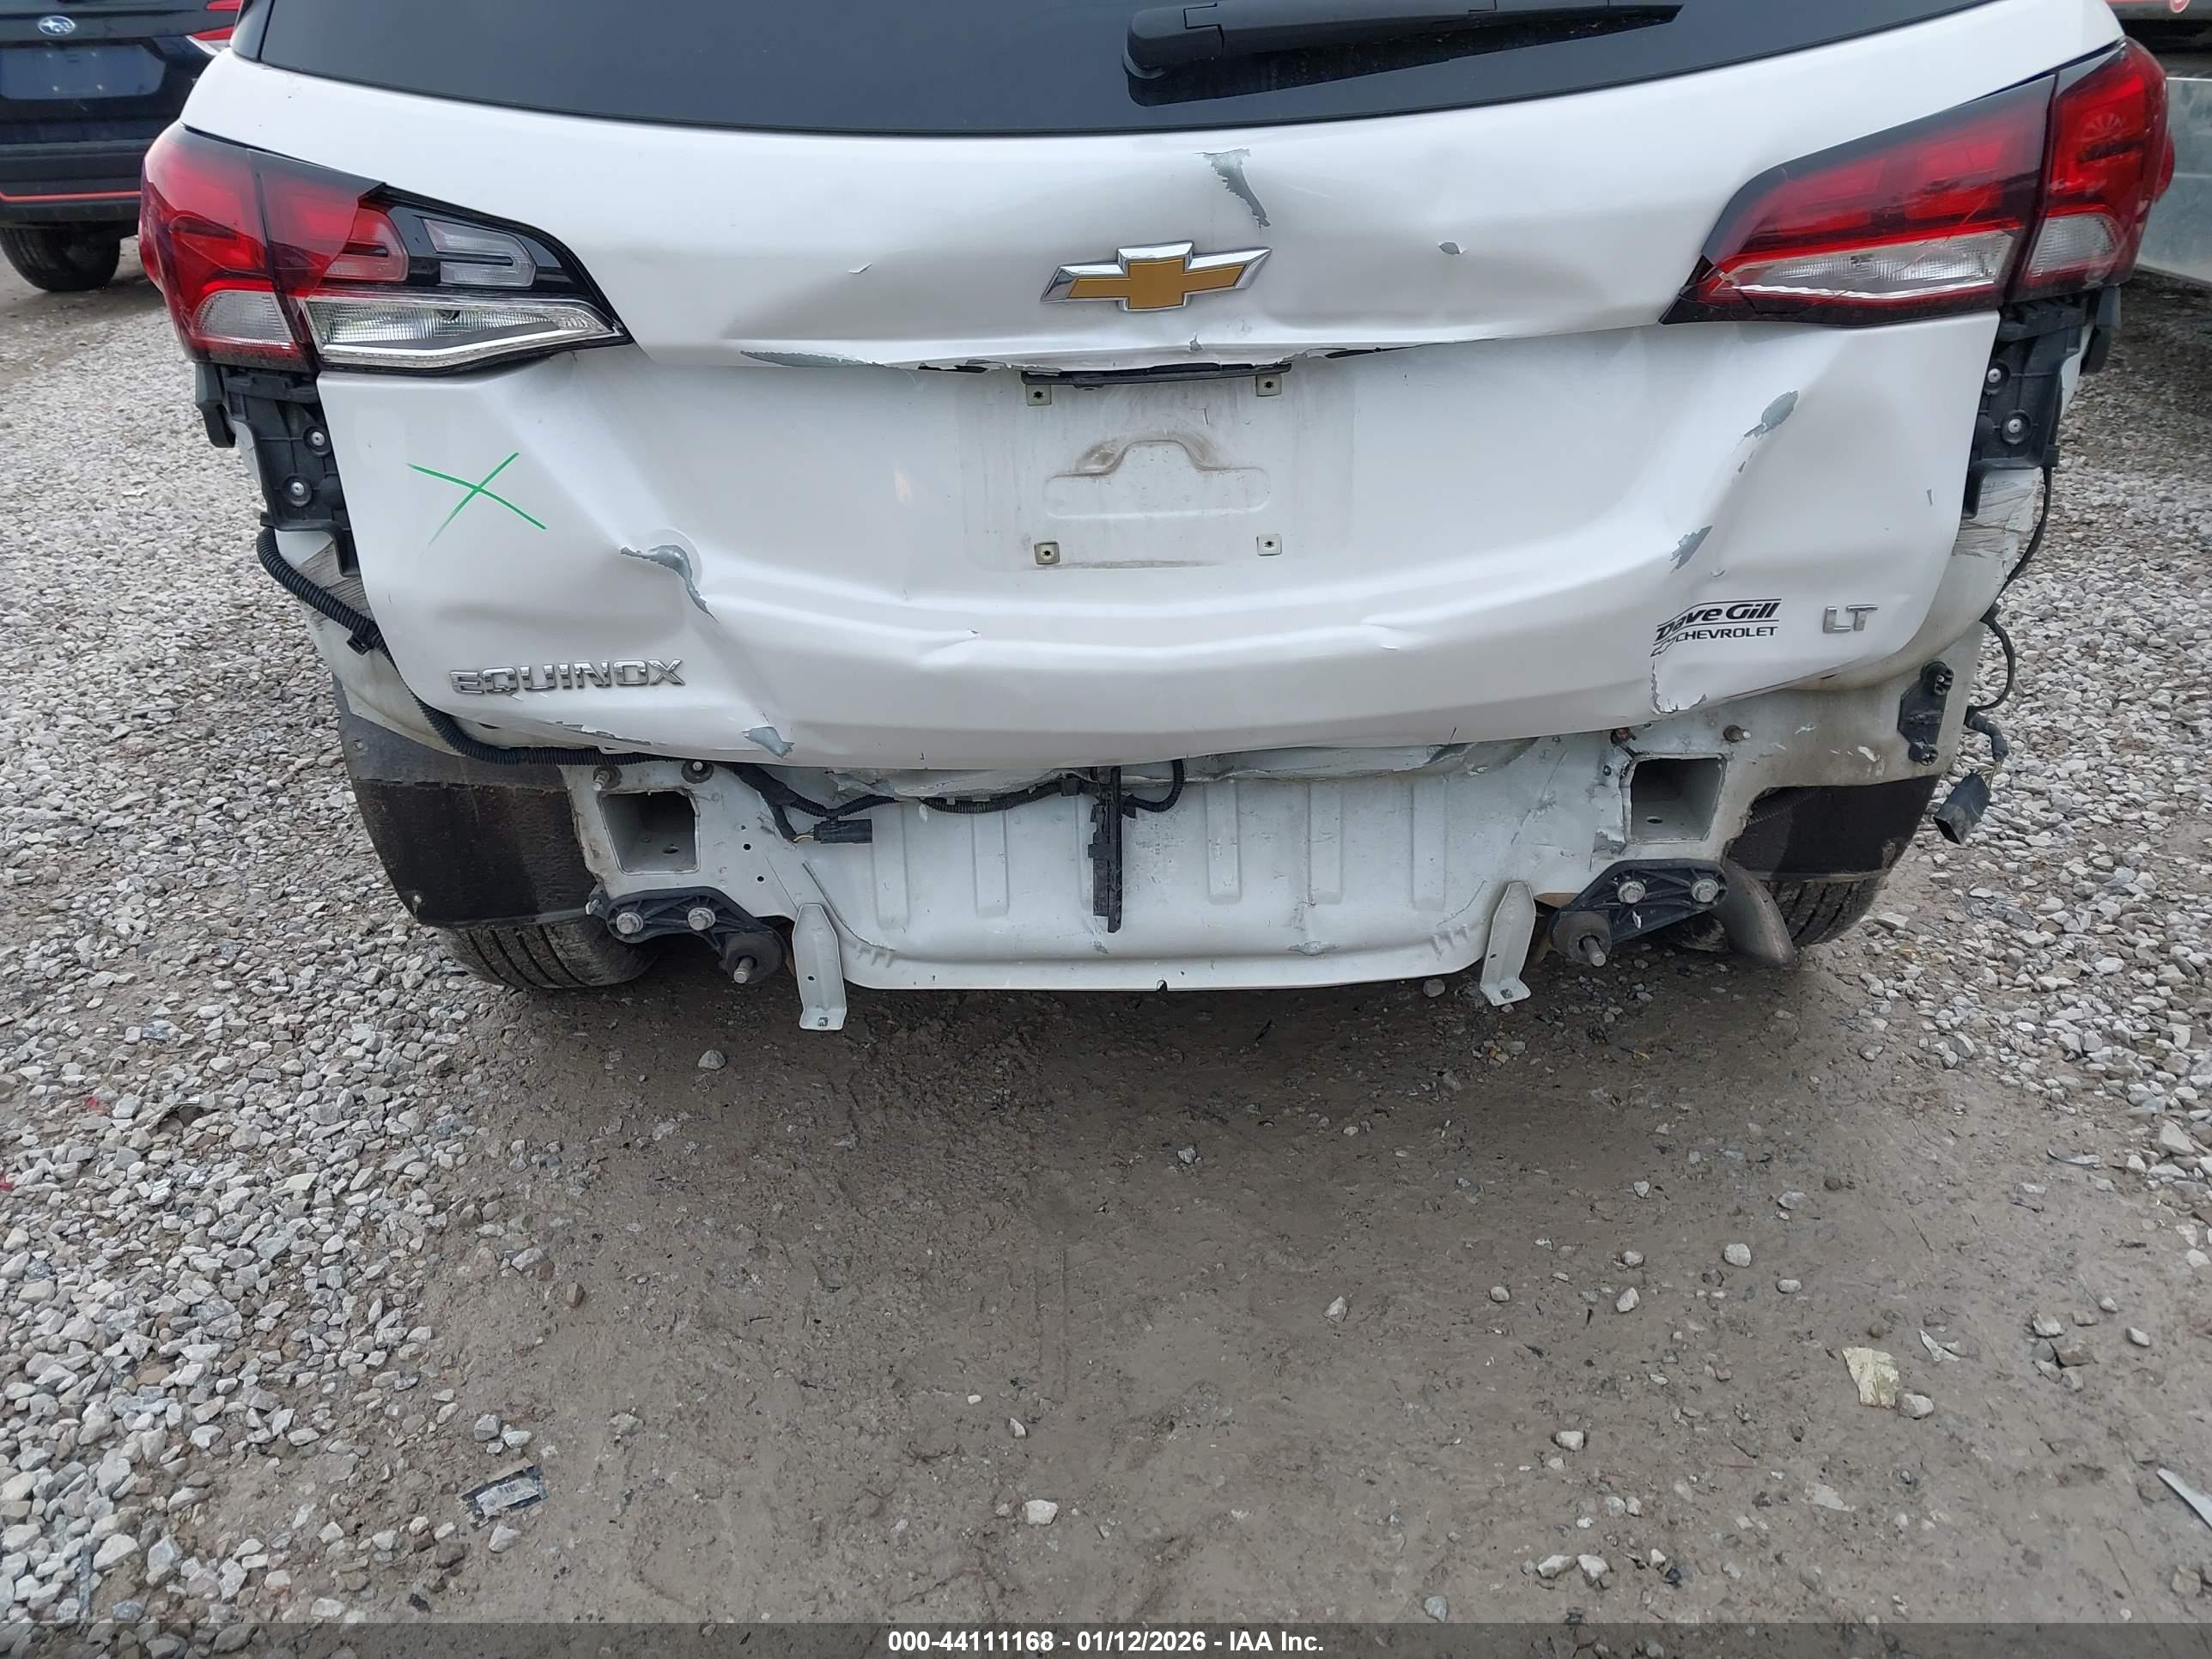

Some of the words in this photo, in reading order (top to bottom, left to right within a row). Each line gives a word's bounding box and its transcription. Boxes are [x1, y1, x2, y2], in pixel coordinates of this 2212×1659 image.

[1655, 608, 1723, 641] Dave
[1725, 602, 1781, 620] Gill
[1674, 626, 1778, 643] CHEVROLET
[1822, 605, 1879, 634] LT
[449, 659, 686, 694] EQUINOX
